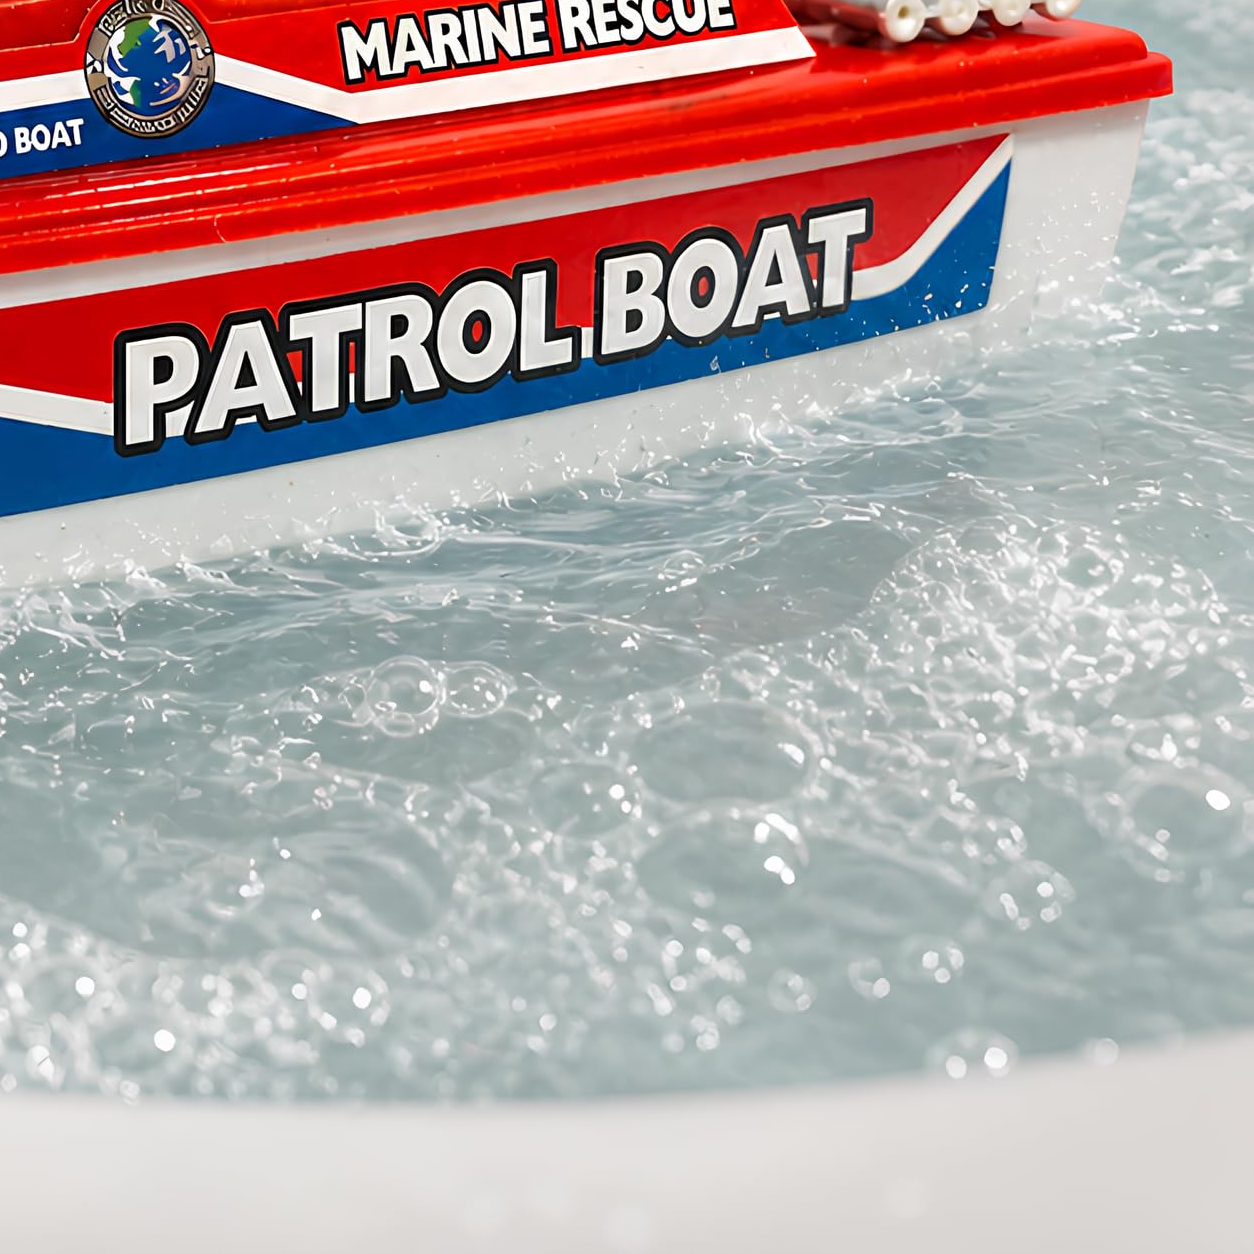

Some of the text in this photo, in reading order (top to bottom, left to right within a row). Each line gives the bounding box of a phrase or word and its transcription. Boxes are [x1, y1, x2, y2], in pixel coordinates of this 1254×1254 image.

[13, 118, 85, 154] BOAT
[117, 199, 872, 454] PATROL BOAT
